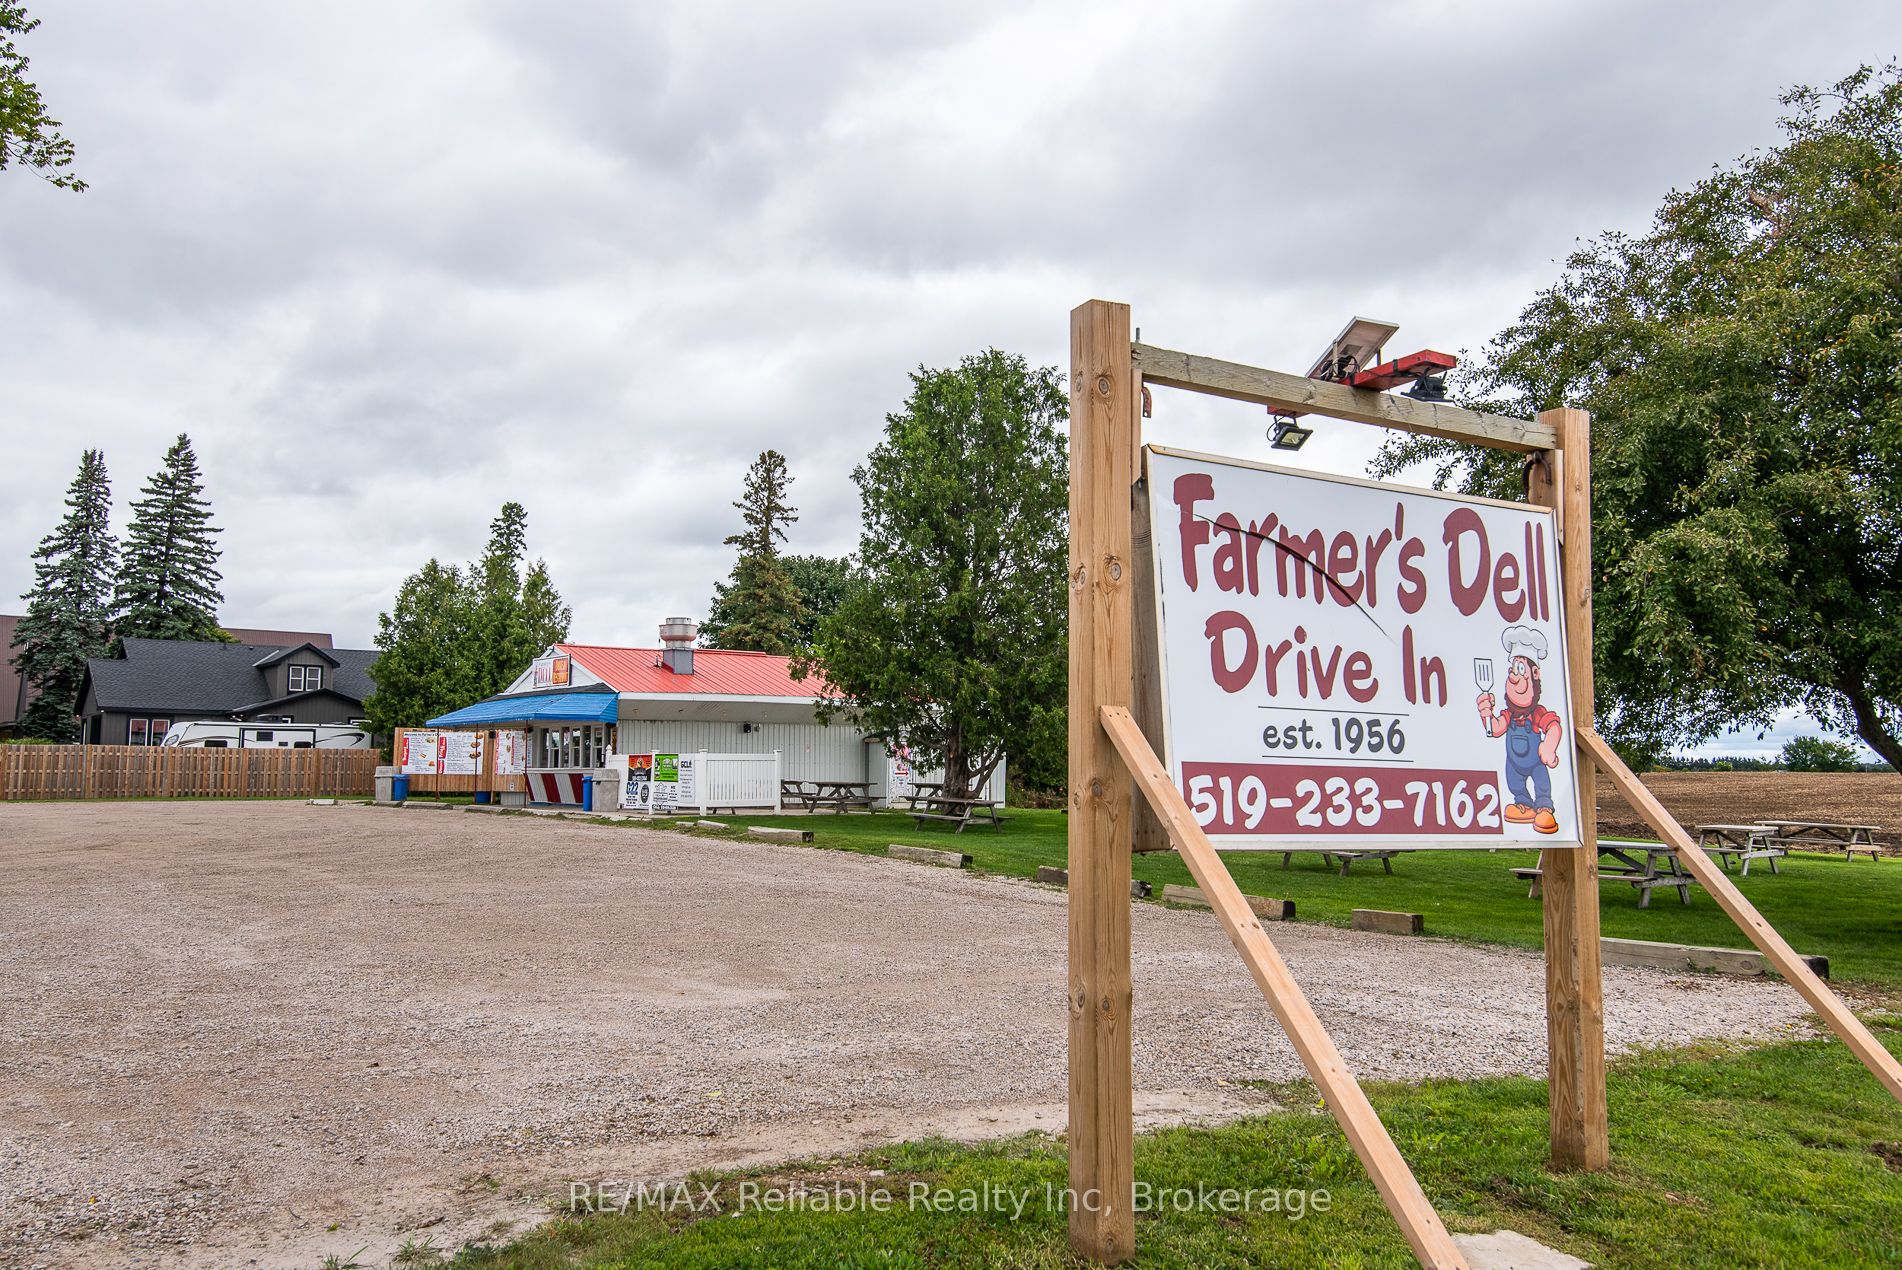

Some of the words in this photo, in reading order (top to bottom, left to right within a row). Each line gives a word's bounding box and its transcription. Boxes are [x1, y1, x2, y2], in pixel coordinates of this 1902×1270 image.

[1173, 473, 1427, 614] Farmer's
[1443, 507, 1550, 622] Dell
[1204, 610, 1379, 702] Drive
[1402, 624, 1448, 707] In
[1262, 721, 1322, 750] est.
[1332, 718, 1405, 754] 1956
[1188, 774, 1500, 830] 519-233-7162
